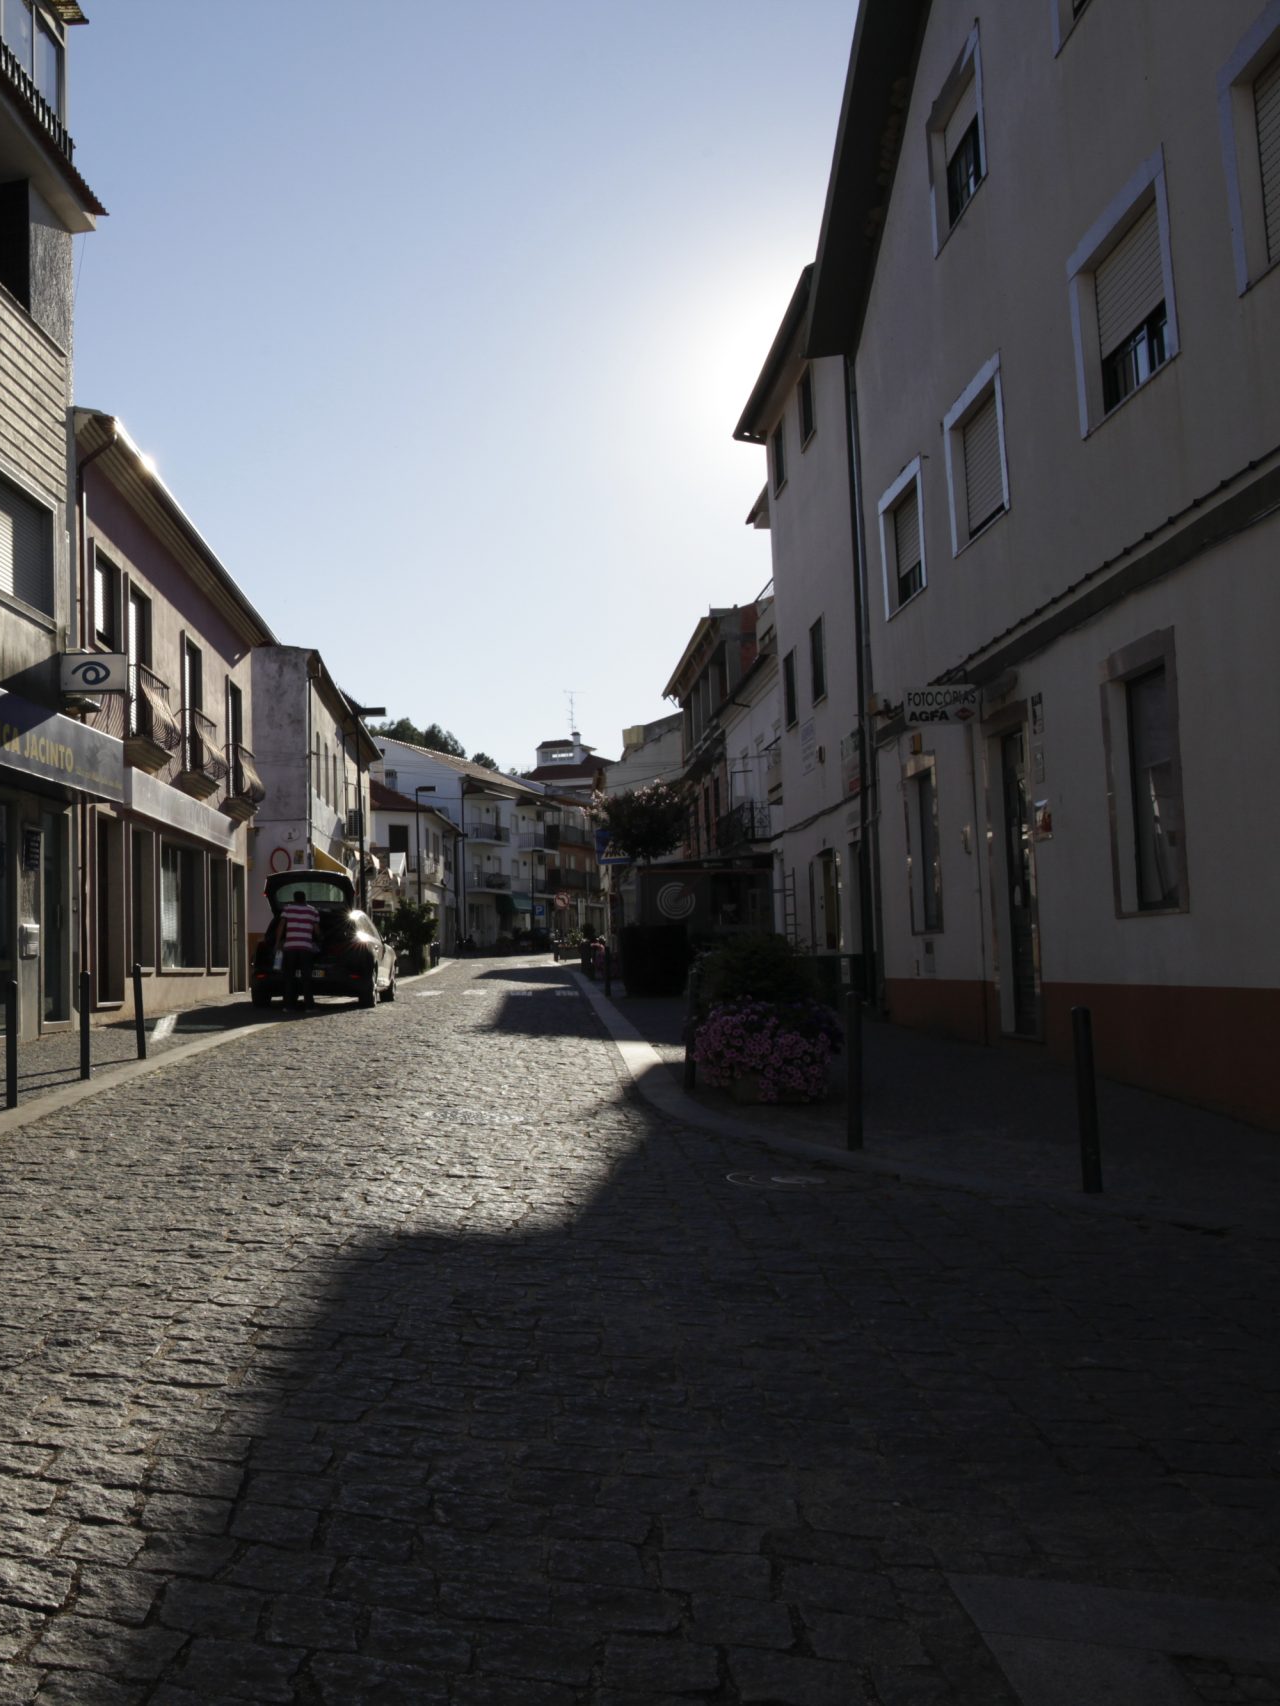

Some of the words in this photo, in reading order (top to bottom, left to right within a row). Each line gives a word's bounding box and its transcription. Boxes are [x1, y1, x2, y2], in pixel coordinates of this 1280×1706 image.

[907, 690, 977, 706] FOTOCÓPIAS
[909, 709, 949, 722] AGFA
[24, 731, 74, 773] JACINTO
